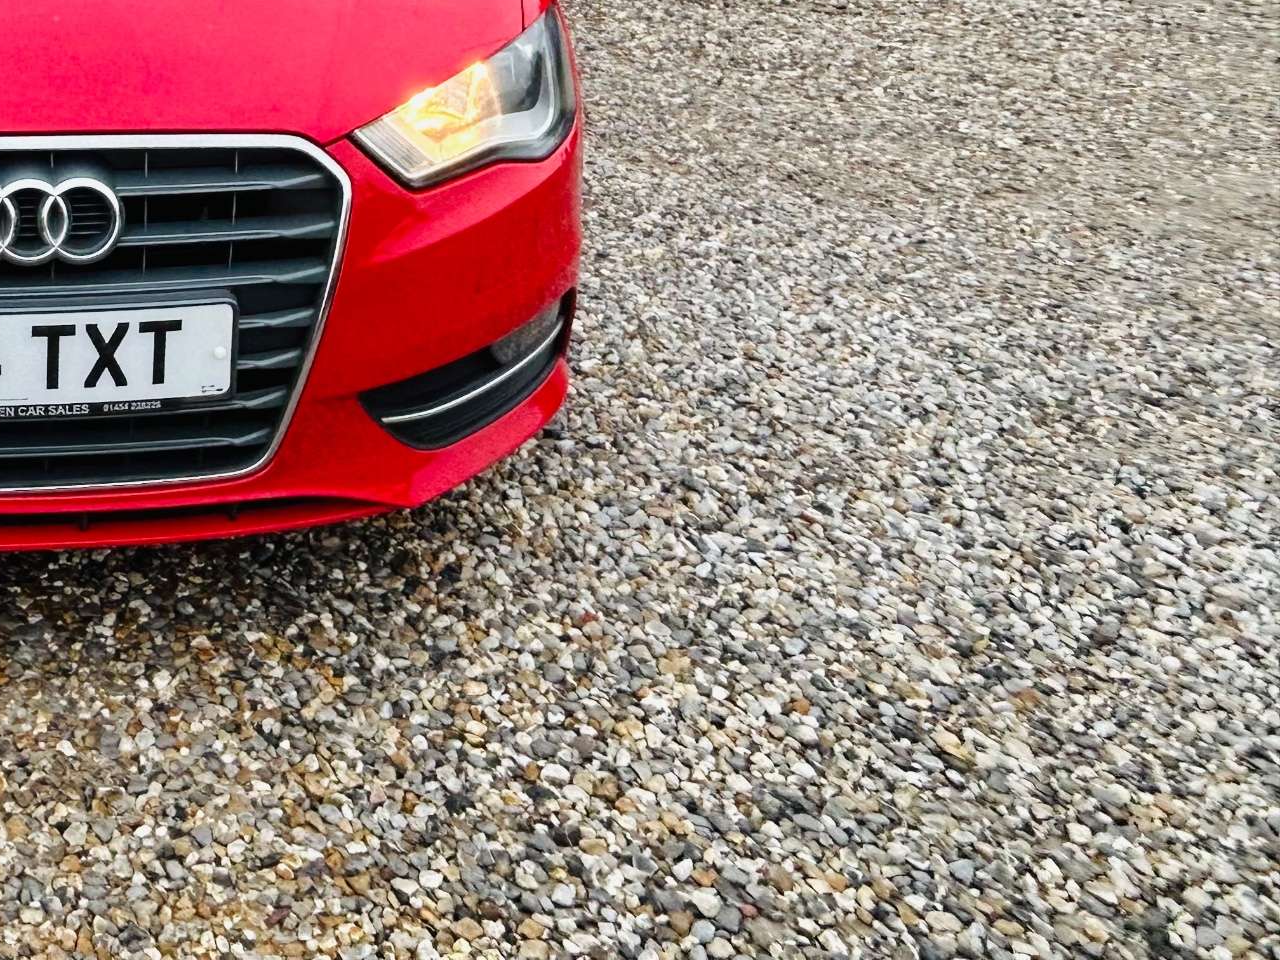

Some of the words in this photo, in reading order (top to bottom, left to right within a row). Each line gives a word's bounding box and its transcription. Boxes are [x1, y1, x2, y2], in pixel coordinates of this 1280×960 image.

[31, 319, 183, 390] TXT
[18, 405, 45, 416] CAR
[48, 403, 90, 415] SALES
